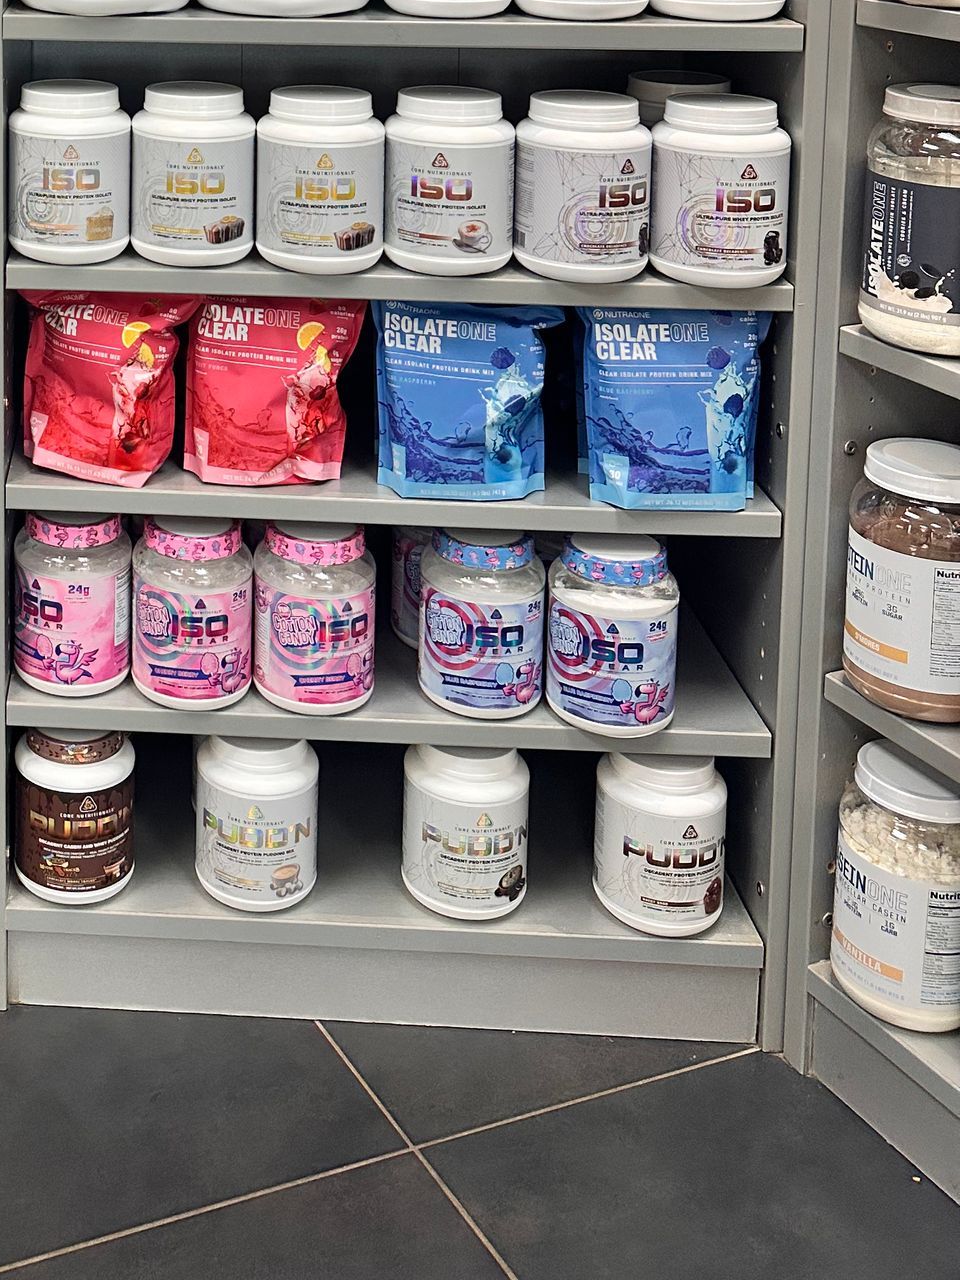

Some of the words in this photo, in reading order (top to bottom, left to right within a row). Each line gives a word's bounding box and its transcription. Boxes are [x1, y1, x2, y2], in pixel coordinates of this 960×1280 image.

[42, 168, 100, 191] ISO
[165, 171, 226, 195] ISO
[294, 177, 356, 200] ISO
[411, 175, 473, 201] ISO
[599, 182, 646, 208] ISO
[715, 188, 776, 213] ISO
[867, 181, 887, 298] ISOLATEONE
[200, 303, 301, 329] ISOLATEONE
[604, 310, 650, 319] NUTRAONE
[198, 319, 249, 341] CLEAR
[384, 312, 496, 342] ISOLATEONE
[594, 323, 709, 342] ISOLATEONE
[384, 330, 442, 354] CLEAR
[596, 341, 657, 361] CLEAR
[68, 584, 90, 596] 24g
[882, 610, 903, 621] SUGAR
[887, 603, 898, 613] 3G
[171, 613, 228, 637] ISO
[274, 611, 318, 632] COTTON
[319, 617, 369, 642] ISO
[649, 621, 667, 632] 24g
[279, 628, 317, 646] CANDY
[464, 625, 524, 648] ISO
[872, 903, 907, 923] CASEIN
[885, 920, 895, 929] 1G
[881, 925, 898, 936] CARB
[841, 936, 882, 974] VANILLA
